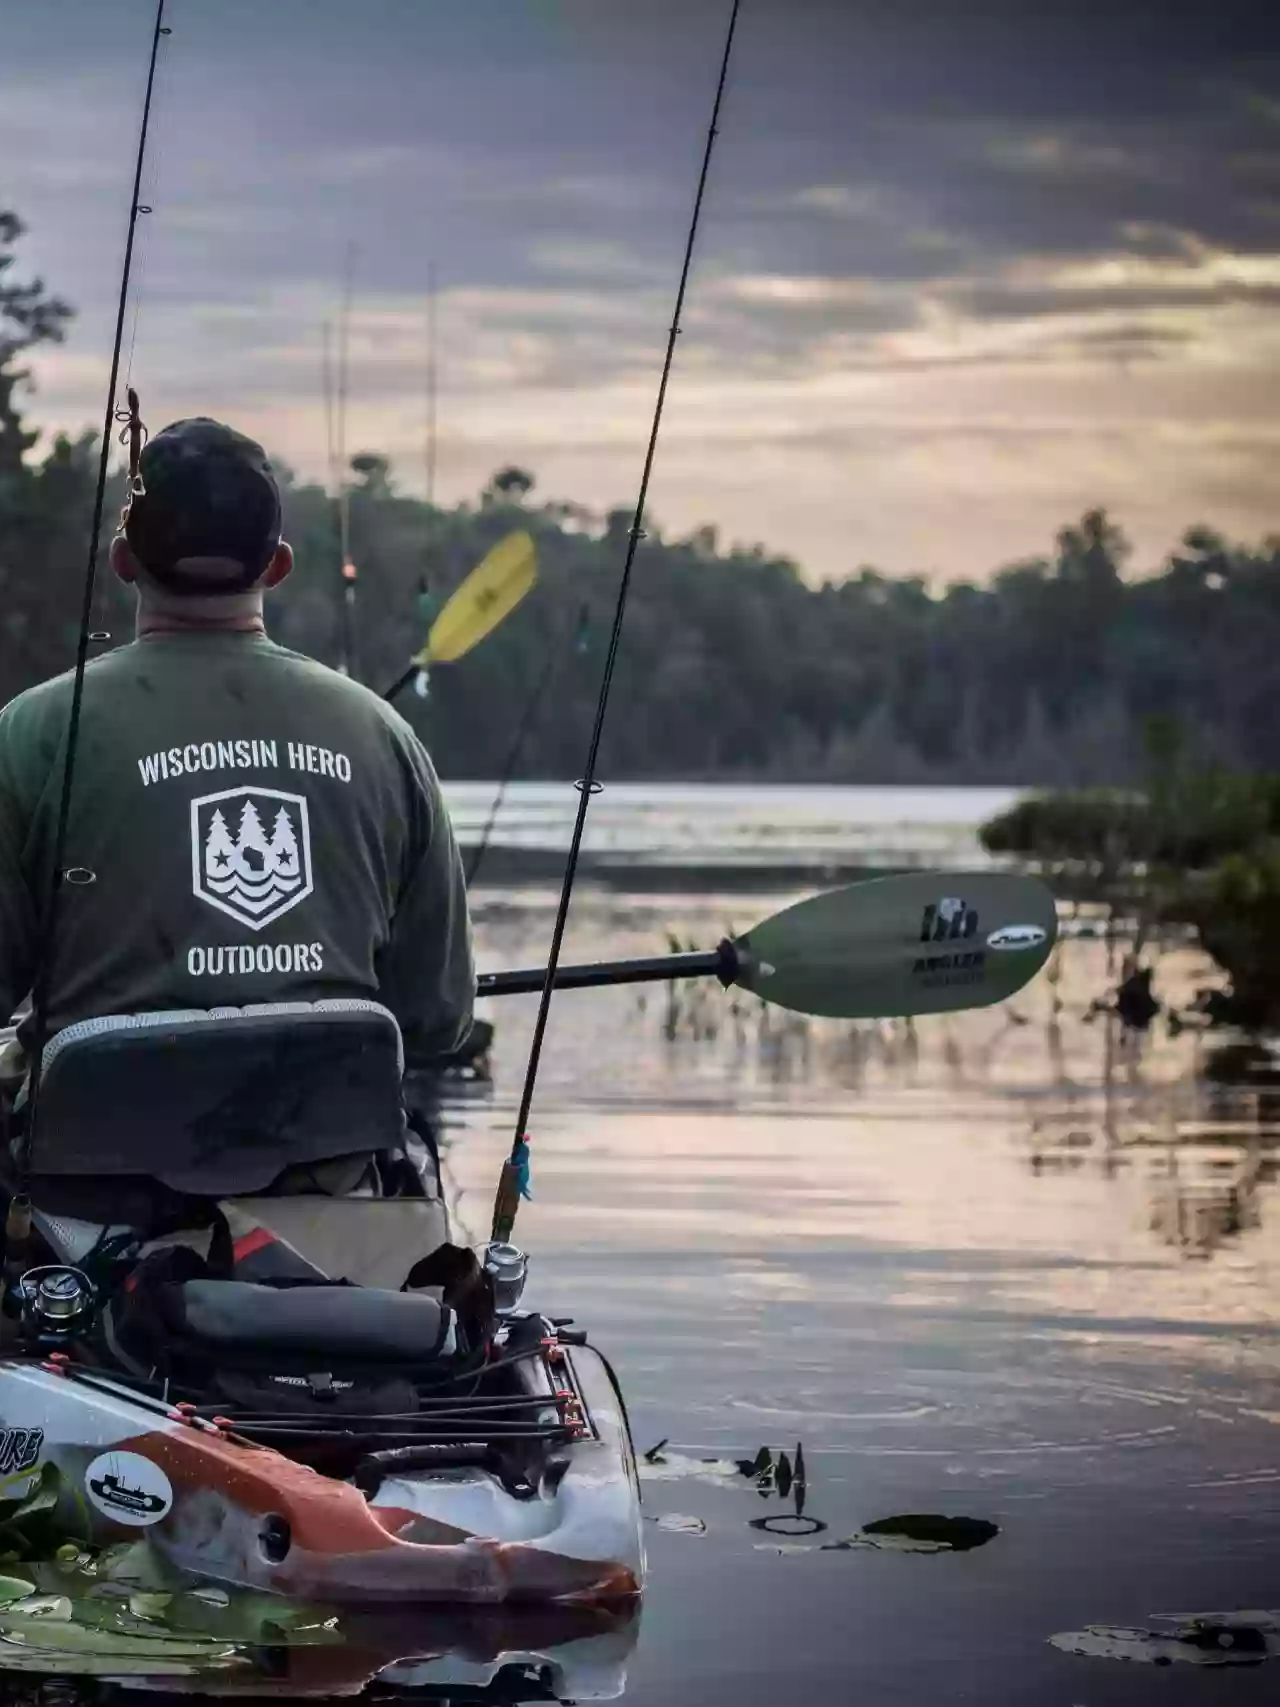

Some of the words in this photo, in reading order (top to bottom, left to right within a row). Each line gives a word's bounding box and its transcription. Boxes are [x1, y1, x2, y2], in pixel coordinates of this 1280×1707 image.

[137, 739, 278, 787] WISCONSIN
[287, 741, 352, 784] HERO
[187, 942, 323, 976] OUTDOORS
